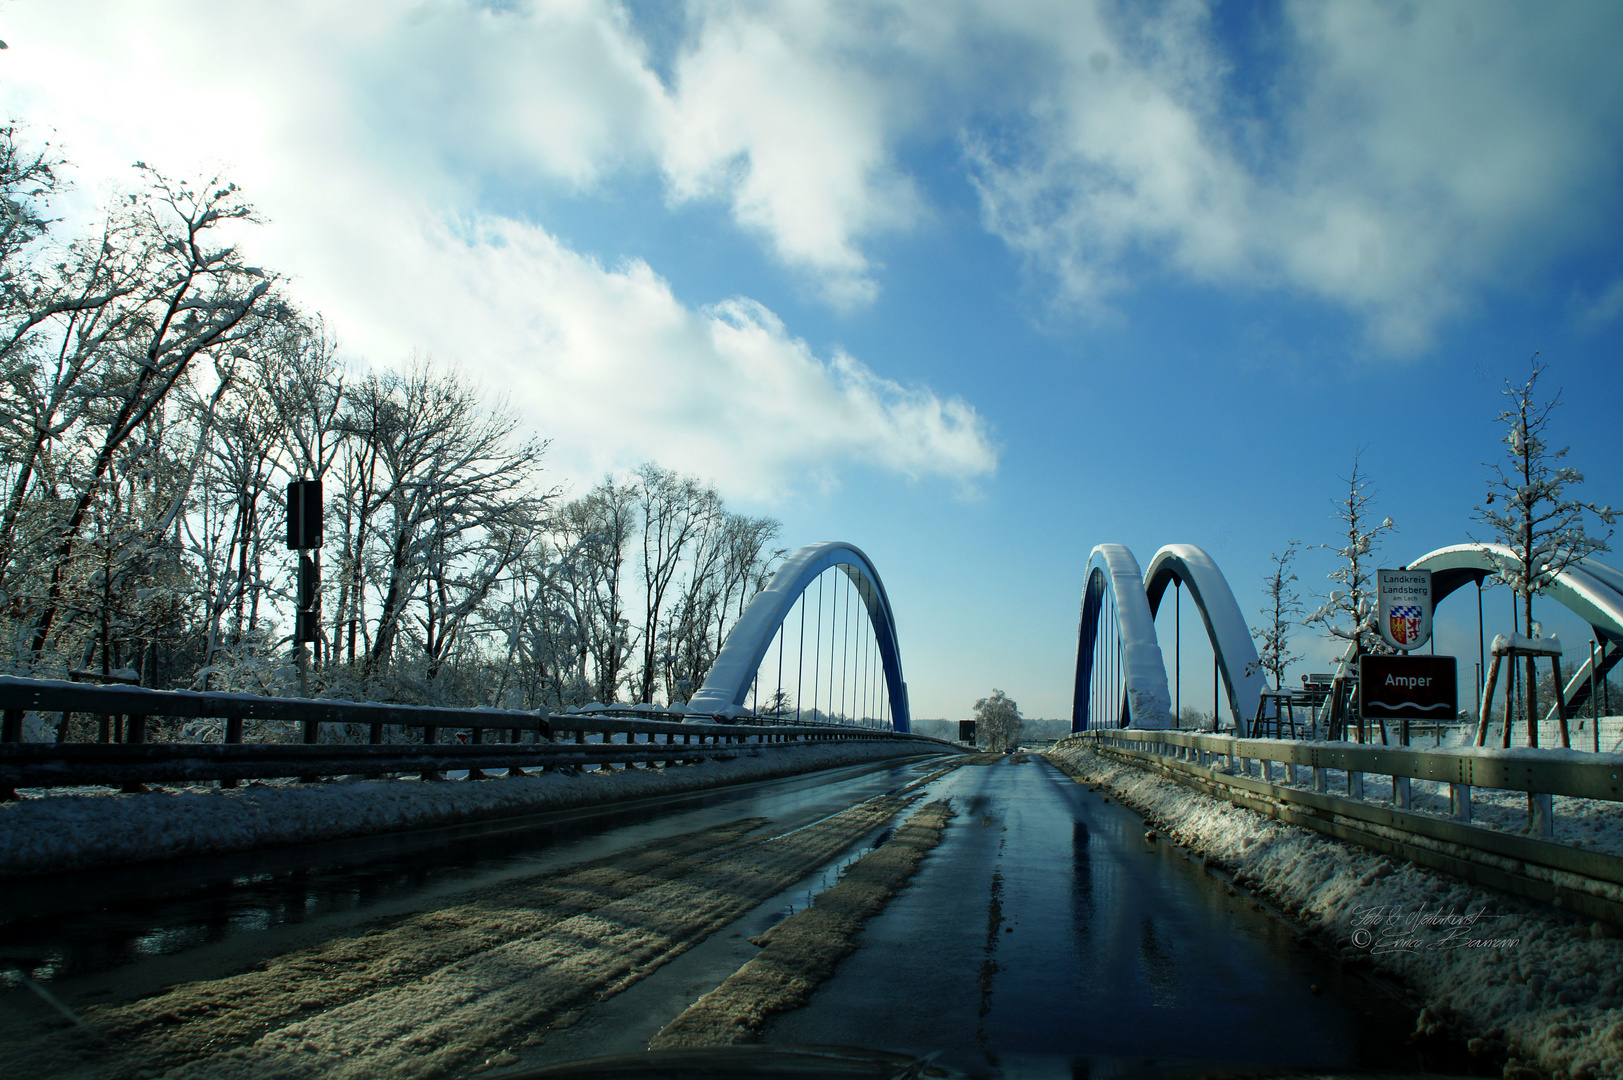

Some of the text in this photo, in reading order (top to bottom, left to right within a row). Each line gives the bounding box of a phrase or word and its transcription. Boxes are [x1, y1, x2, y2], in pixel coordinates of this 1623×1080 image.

[1383, 575, 1426, 584] Landkreis
[1382, 586, 1428, 596] Landsberg
[1384, 673, 1433, 690] Amper
